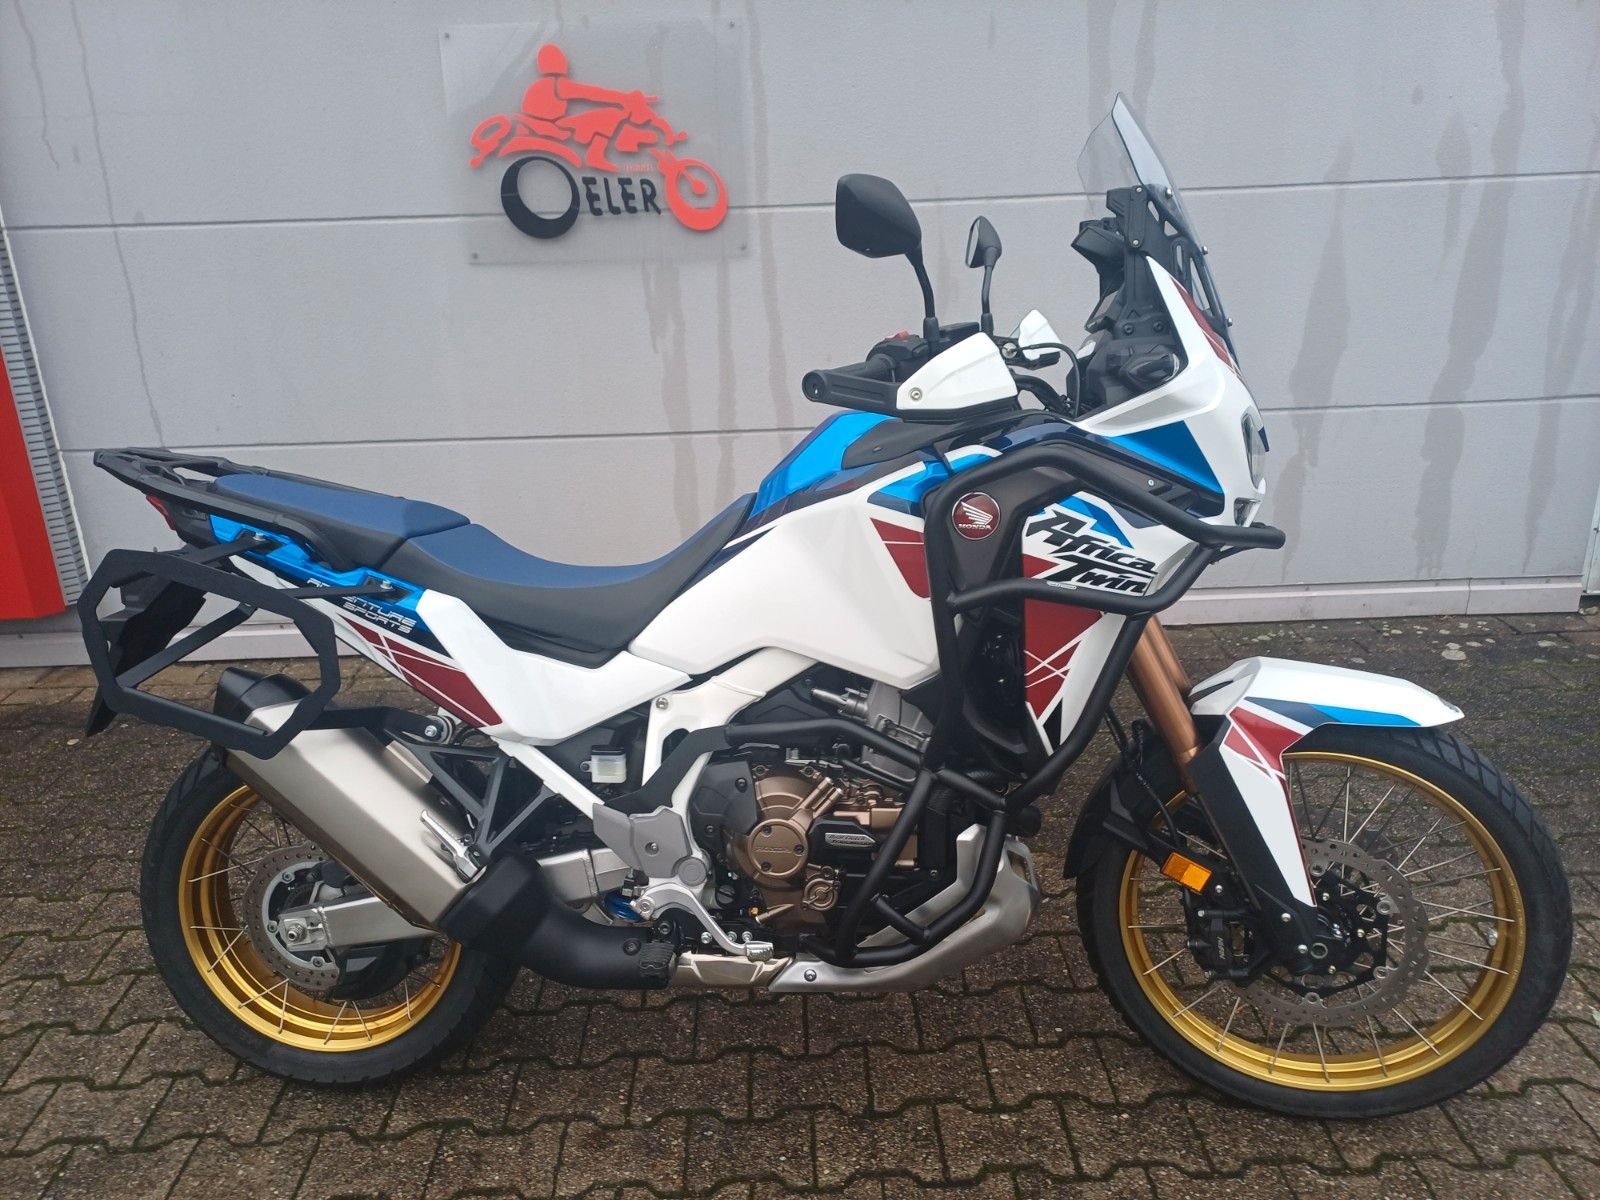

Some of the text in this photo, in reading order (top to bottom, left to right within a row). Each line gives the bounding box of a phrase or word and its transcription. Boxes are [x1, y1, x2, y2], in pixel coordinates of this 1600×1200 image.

[1025, 509, 1158, 571] Africa
[1049, 554, 1158, 593] Twin
[343, 601, 413, 634] SPORTS
